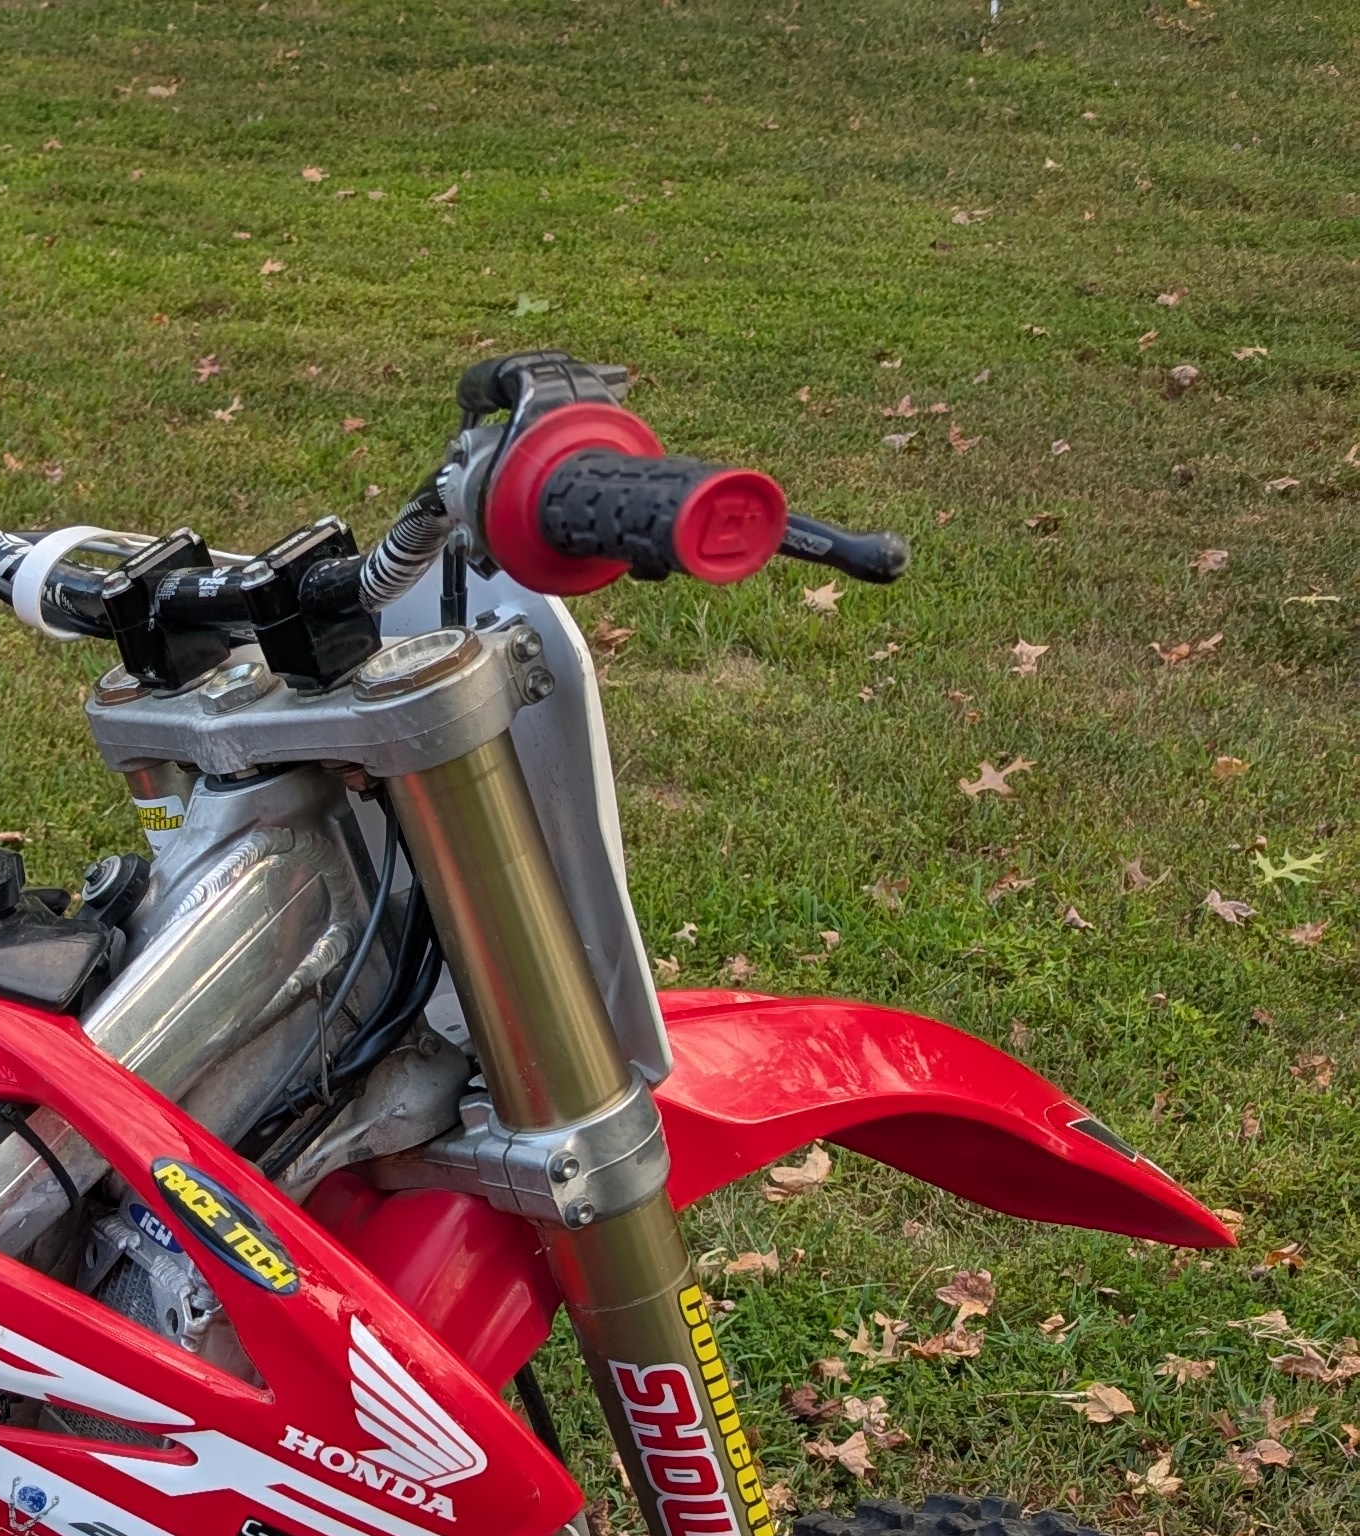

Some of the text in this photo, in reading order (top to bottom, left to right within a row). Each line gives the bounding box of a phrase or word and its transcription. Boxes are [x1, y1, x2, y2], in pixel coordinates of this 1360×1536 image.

[154, 1163, 297, 1290] RACE TECH
[278, 1425, 458, 1522] HONDA
